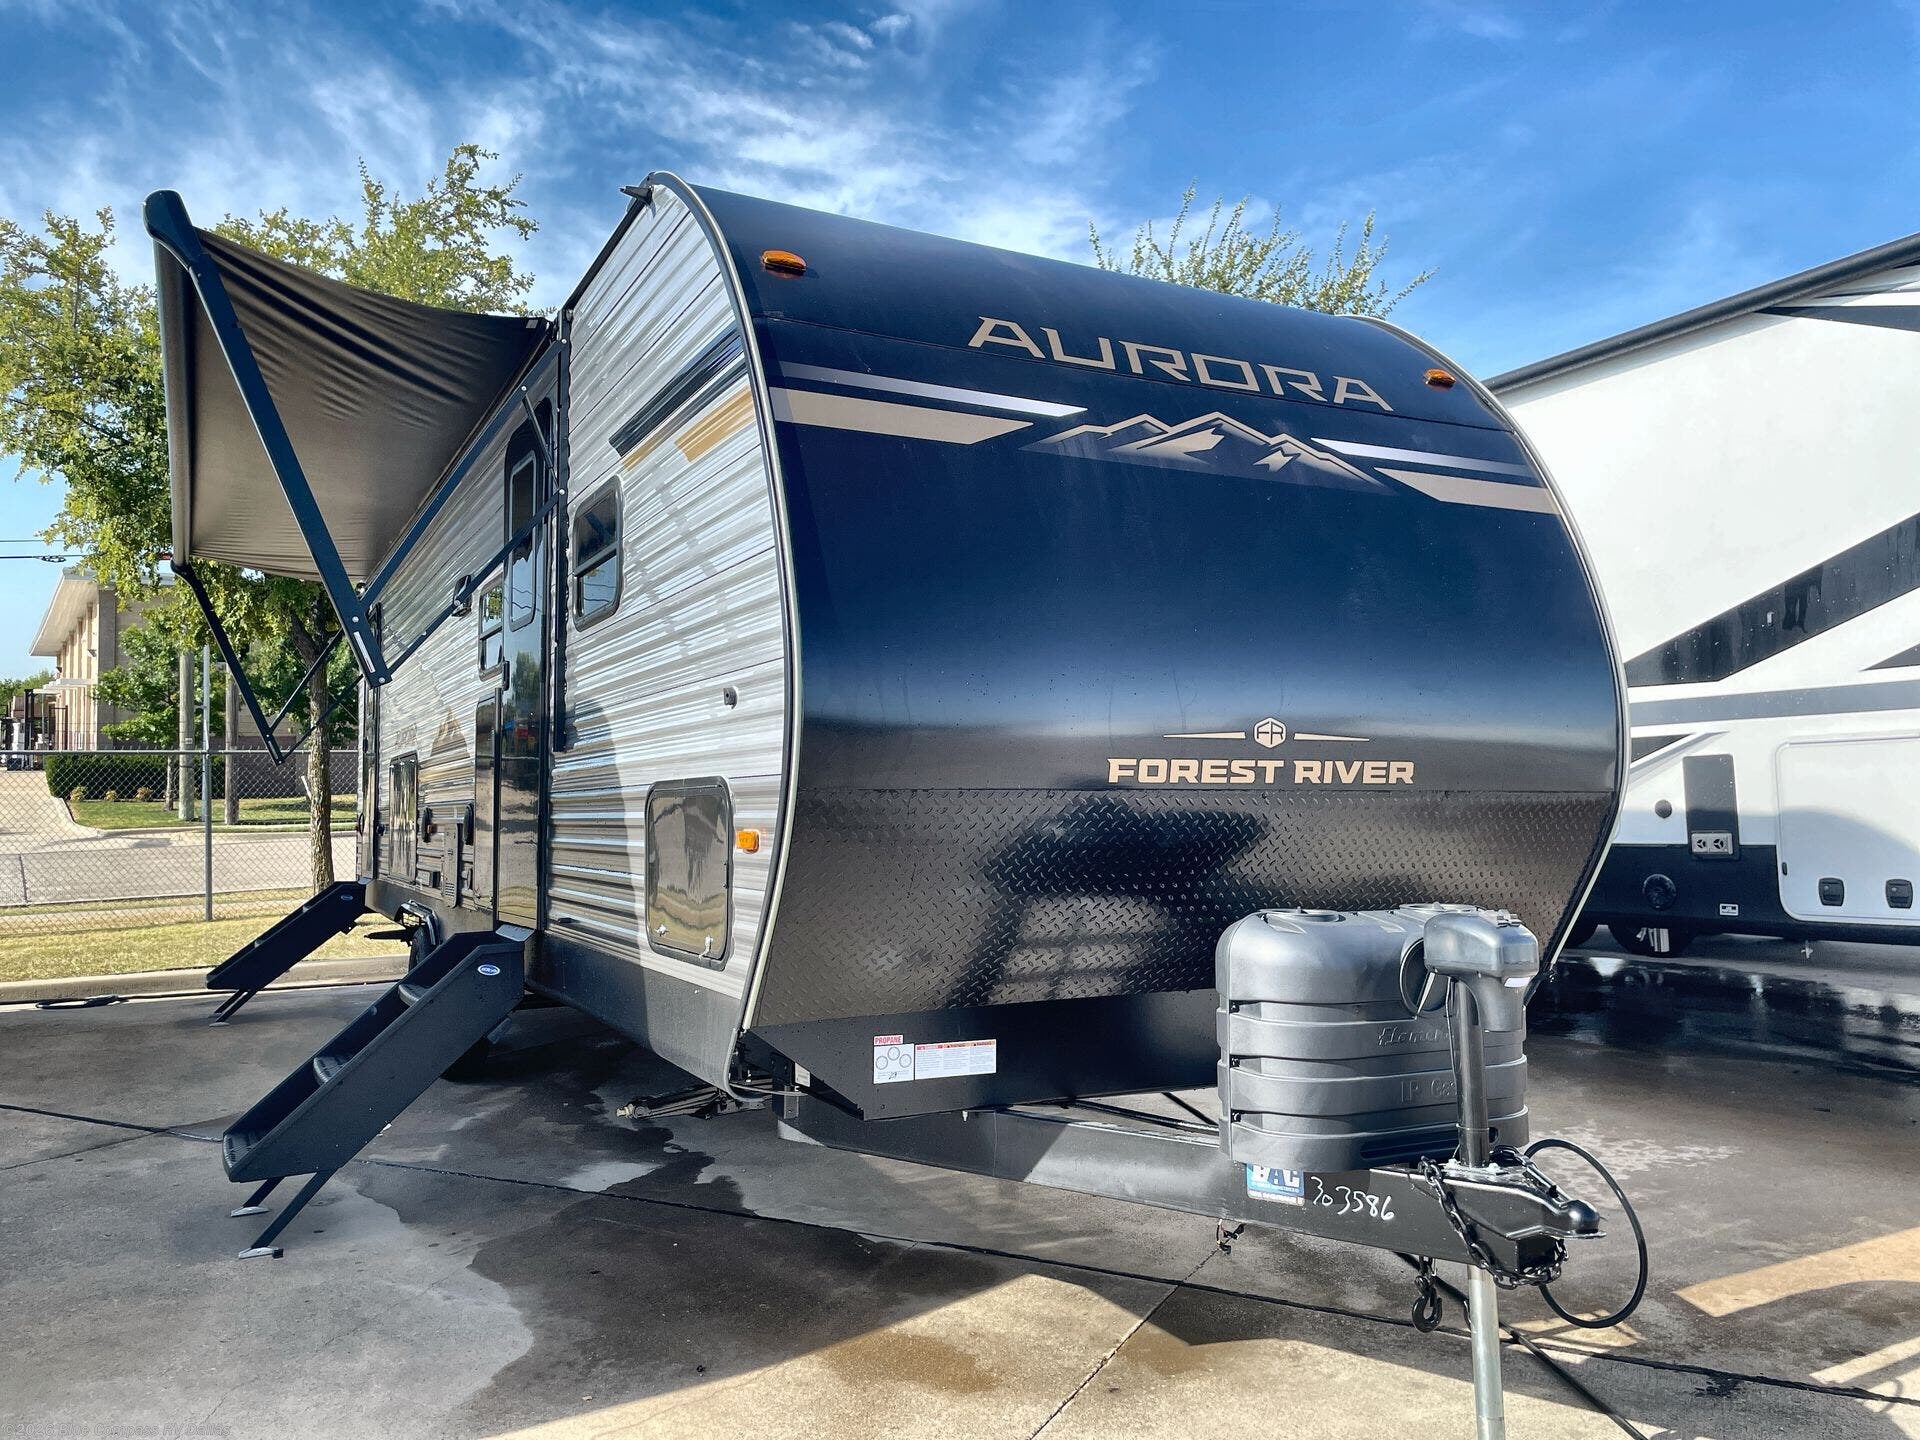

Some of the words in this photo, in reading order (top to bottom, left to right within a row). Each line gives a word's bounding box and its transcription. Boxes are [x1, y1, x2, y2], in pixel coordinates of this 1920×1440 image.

[968, 316, 1394, 411] AURORA
[1107, 758, 1284, 784] FOREST
[1293, 760, 1415, 784] RIVER
[875, 1036, 901, 1044] PROPANE
